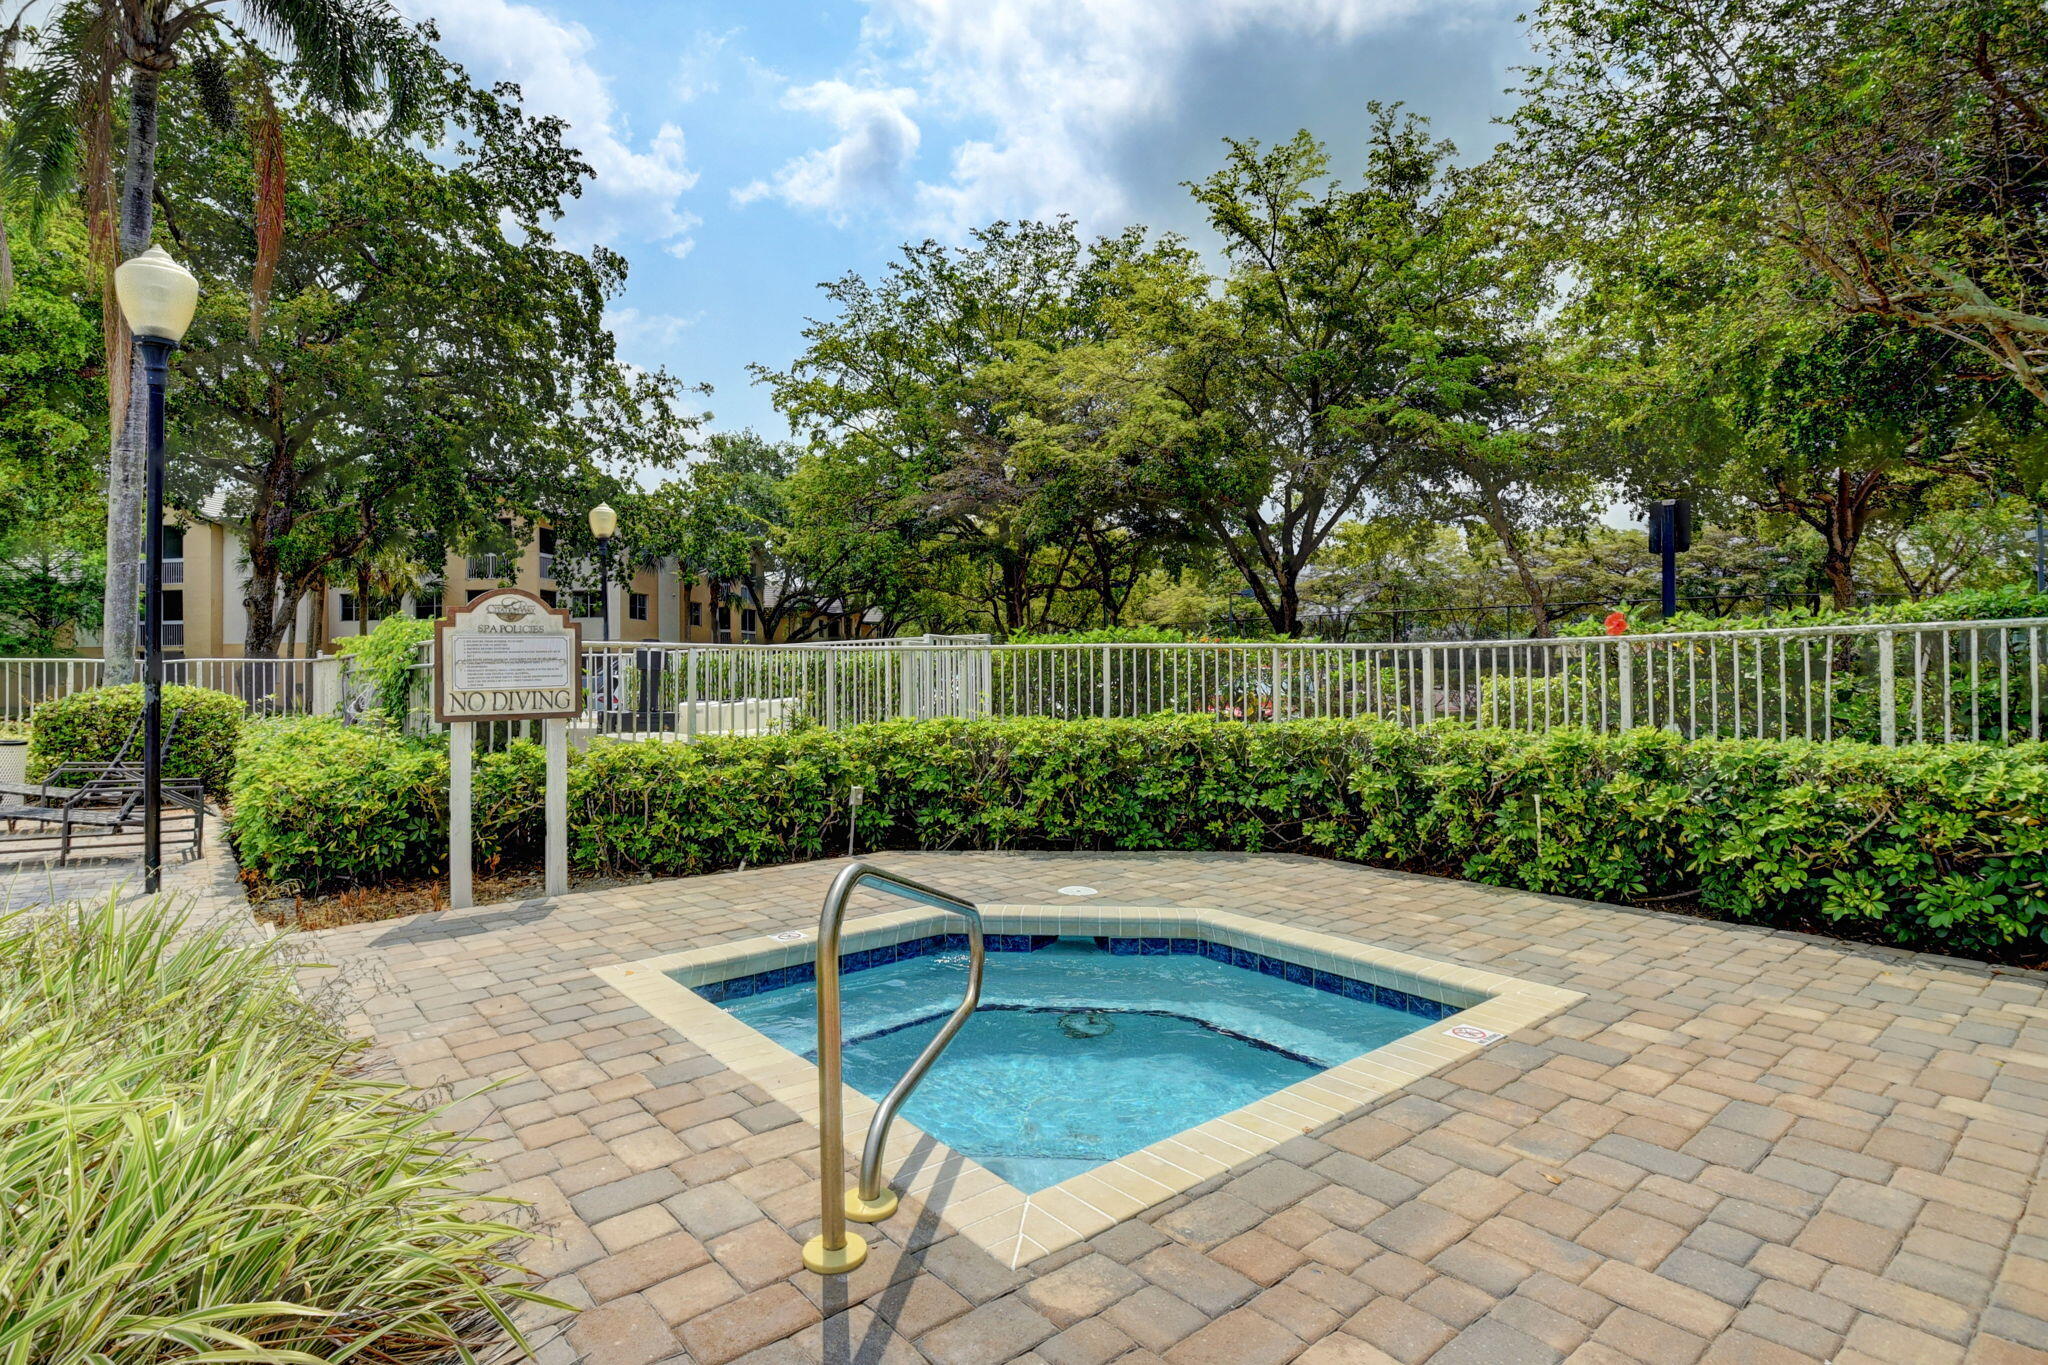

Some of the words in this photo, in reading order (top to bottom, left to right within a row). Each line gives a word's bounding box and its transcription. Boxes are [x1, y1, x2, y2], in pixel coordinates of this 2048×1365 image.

[477, 625, 498, 633] SPA
[499, 624, 545, 634] POLICIES
[450, 692, 486, 713] NO
[493, 690, 570, 711] DIVING
